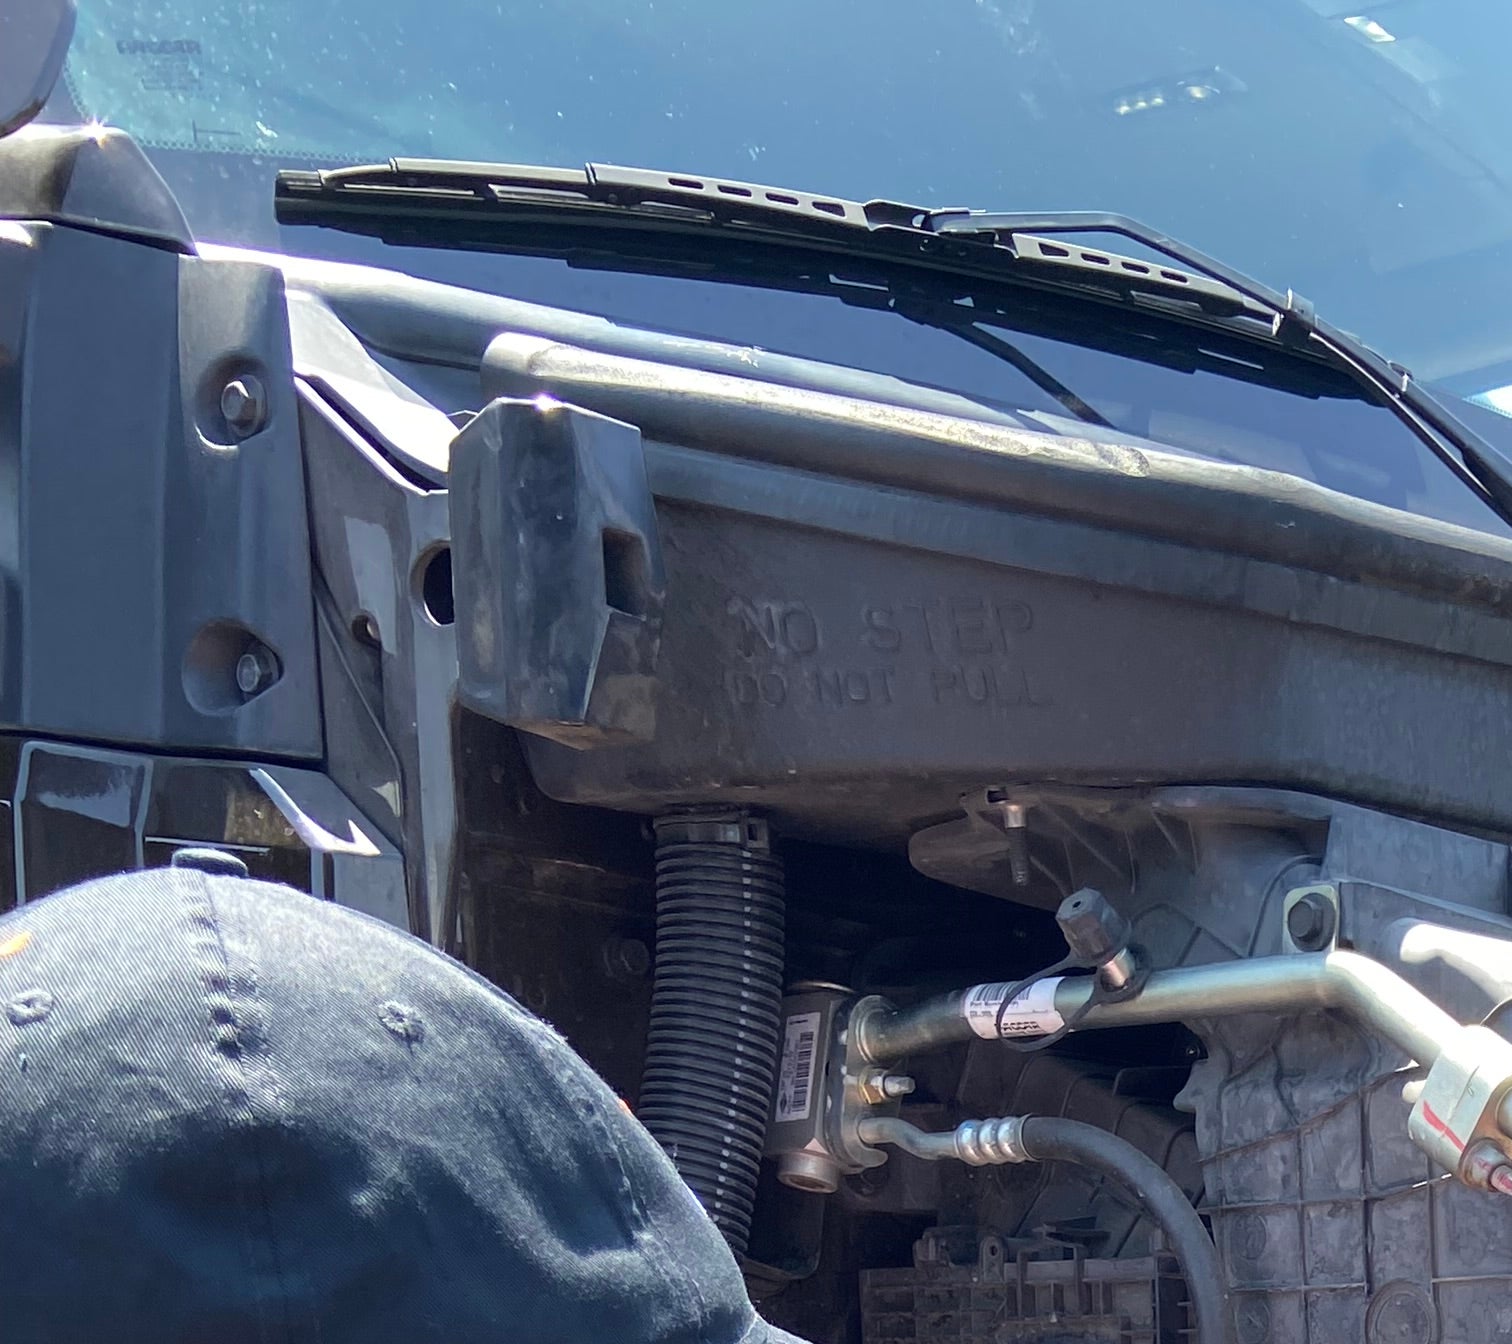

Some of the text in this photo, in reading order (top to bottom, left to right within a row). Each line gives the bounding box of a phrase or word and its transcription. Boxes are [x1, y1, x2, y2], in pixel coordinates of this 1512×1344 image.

[724, 594, 1036, 660] NO STEP
[813, 664, 897, 707] NOT
[930, 663, 1053, 707] PULL
